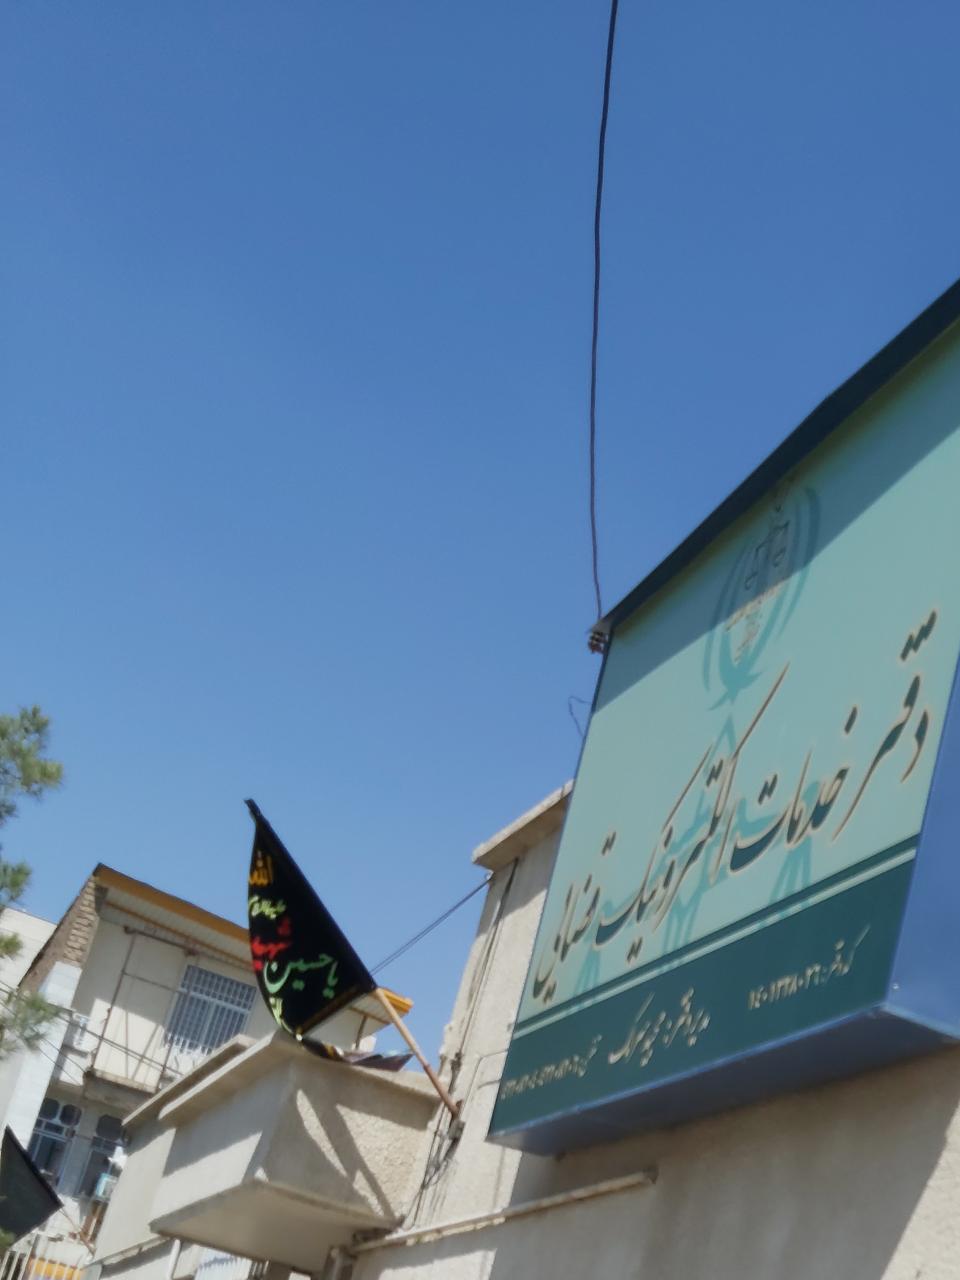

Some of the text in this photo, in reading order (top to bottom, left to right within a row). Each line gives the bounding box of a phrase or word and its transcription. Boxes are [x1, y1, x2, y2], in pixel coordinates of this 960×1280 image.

[728, 704, 859, 874] خدمات
[832, 608, 937, 841] دفتر
[594, 662, 791, 963] الکترونیک
[263, 953, 334, 994] حسین
[531, 831, 616, 1004] قضایی
